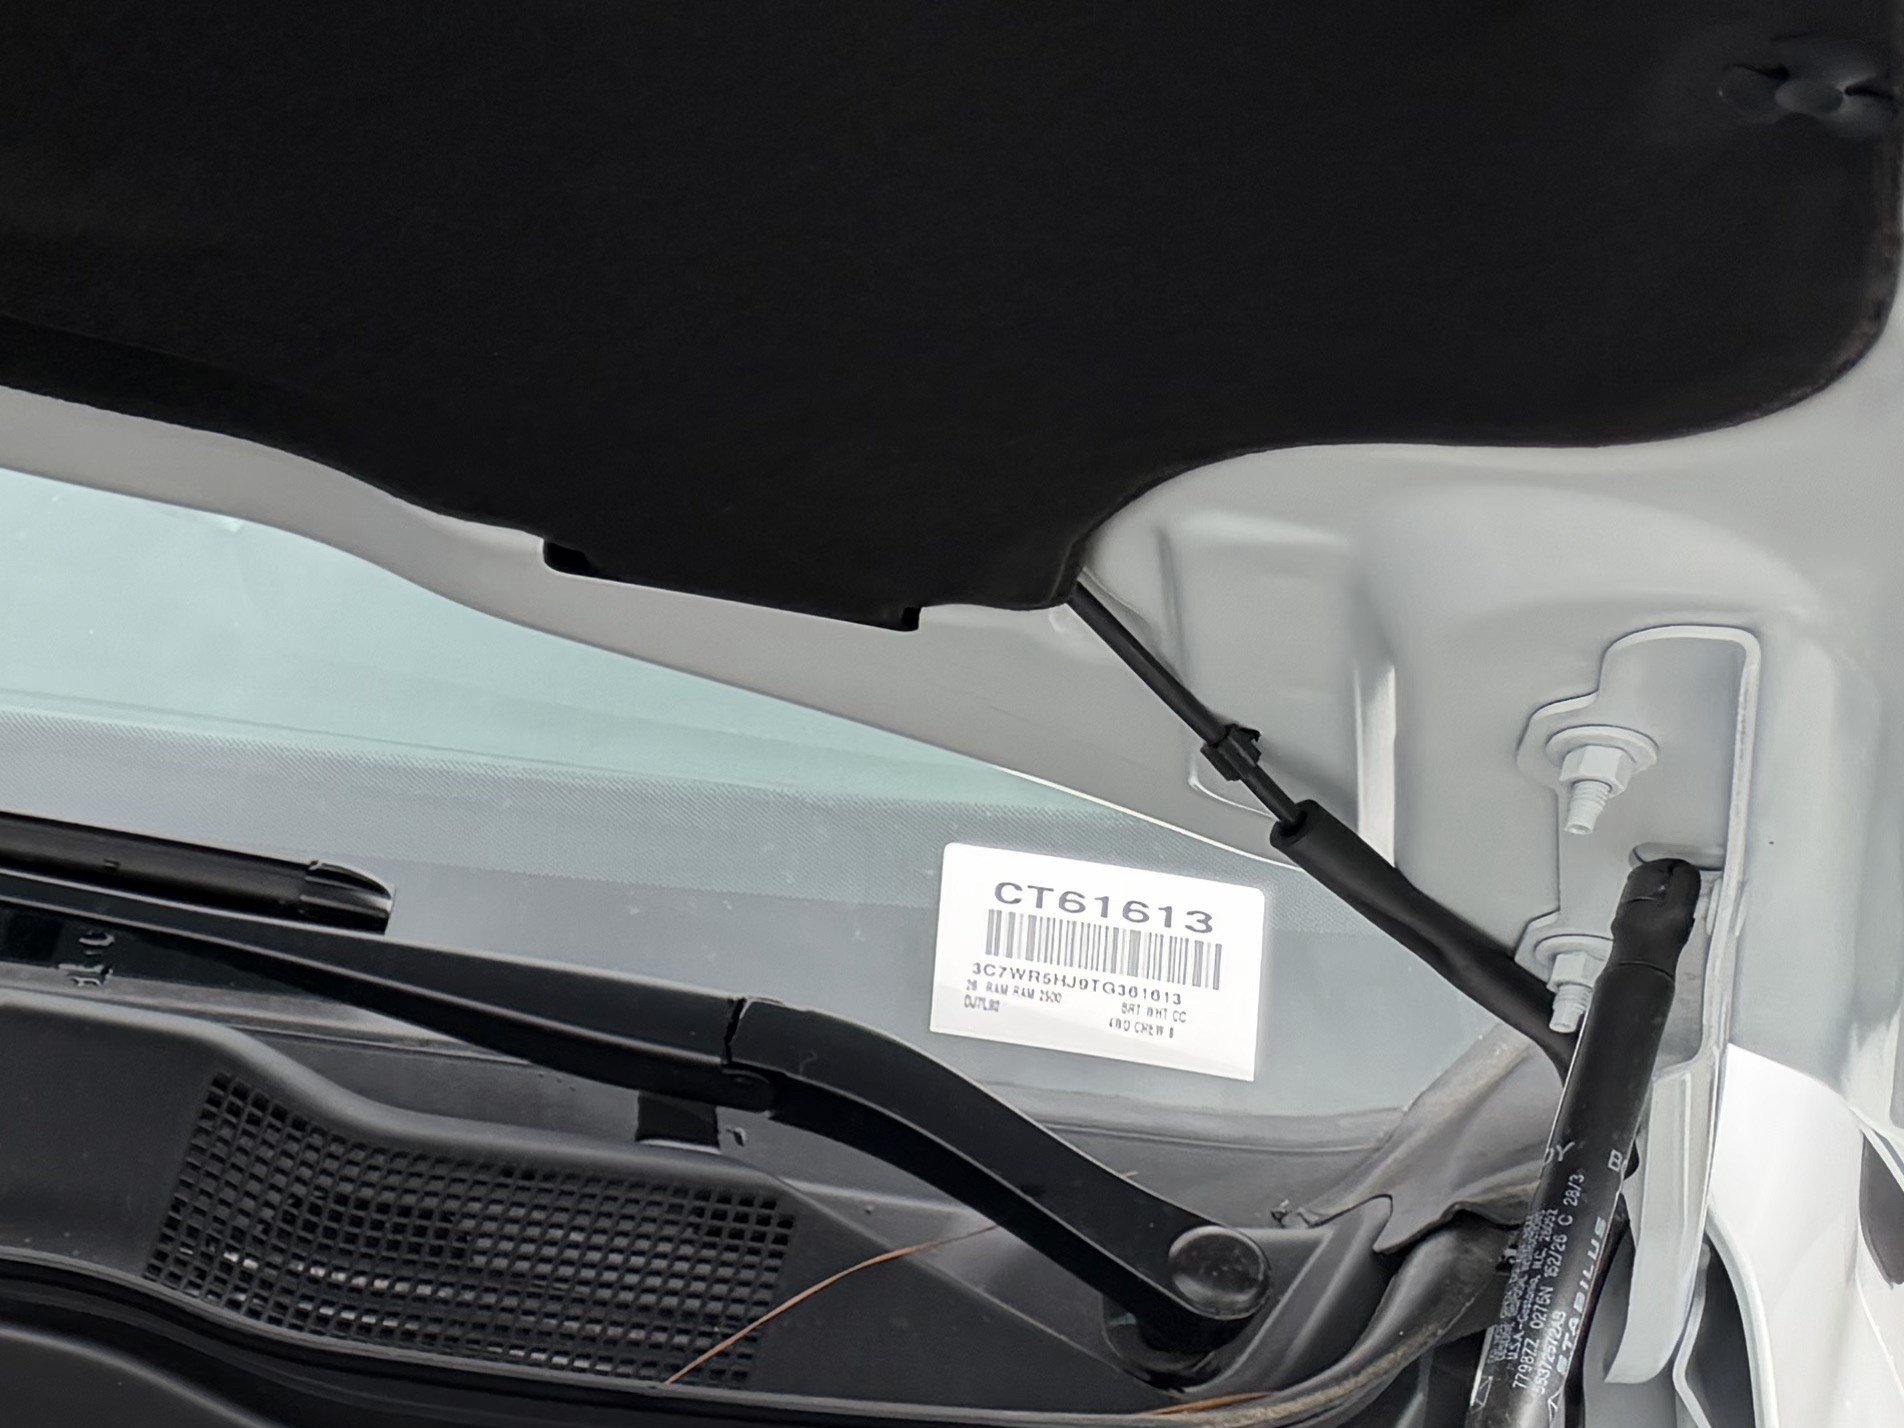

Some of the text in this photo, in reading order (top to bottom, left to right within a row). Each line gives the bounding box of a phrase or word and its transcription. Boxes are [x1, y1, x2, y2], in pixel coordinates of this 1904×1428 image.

[994, 881, 1214, 934] CT61613
[985, 983, 1008, 997] RAM
[1012, 986, 1035, 1001] RAM
[1172, 1009, 1188, 1024] CC
[1563, 1173, 1585, 1207] 28/3
[1557, 1214, 1574, 1227] C
[1557, 1217, 1607, 1376] STABILUS
